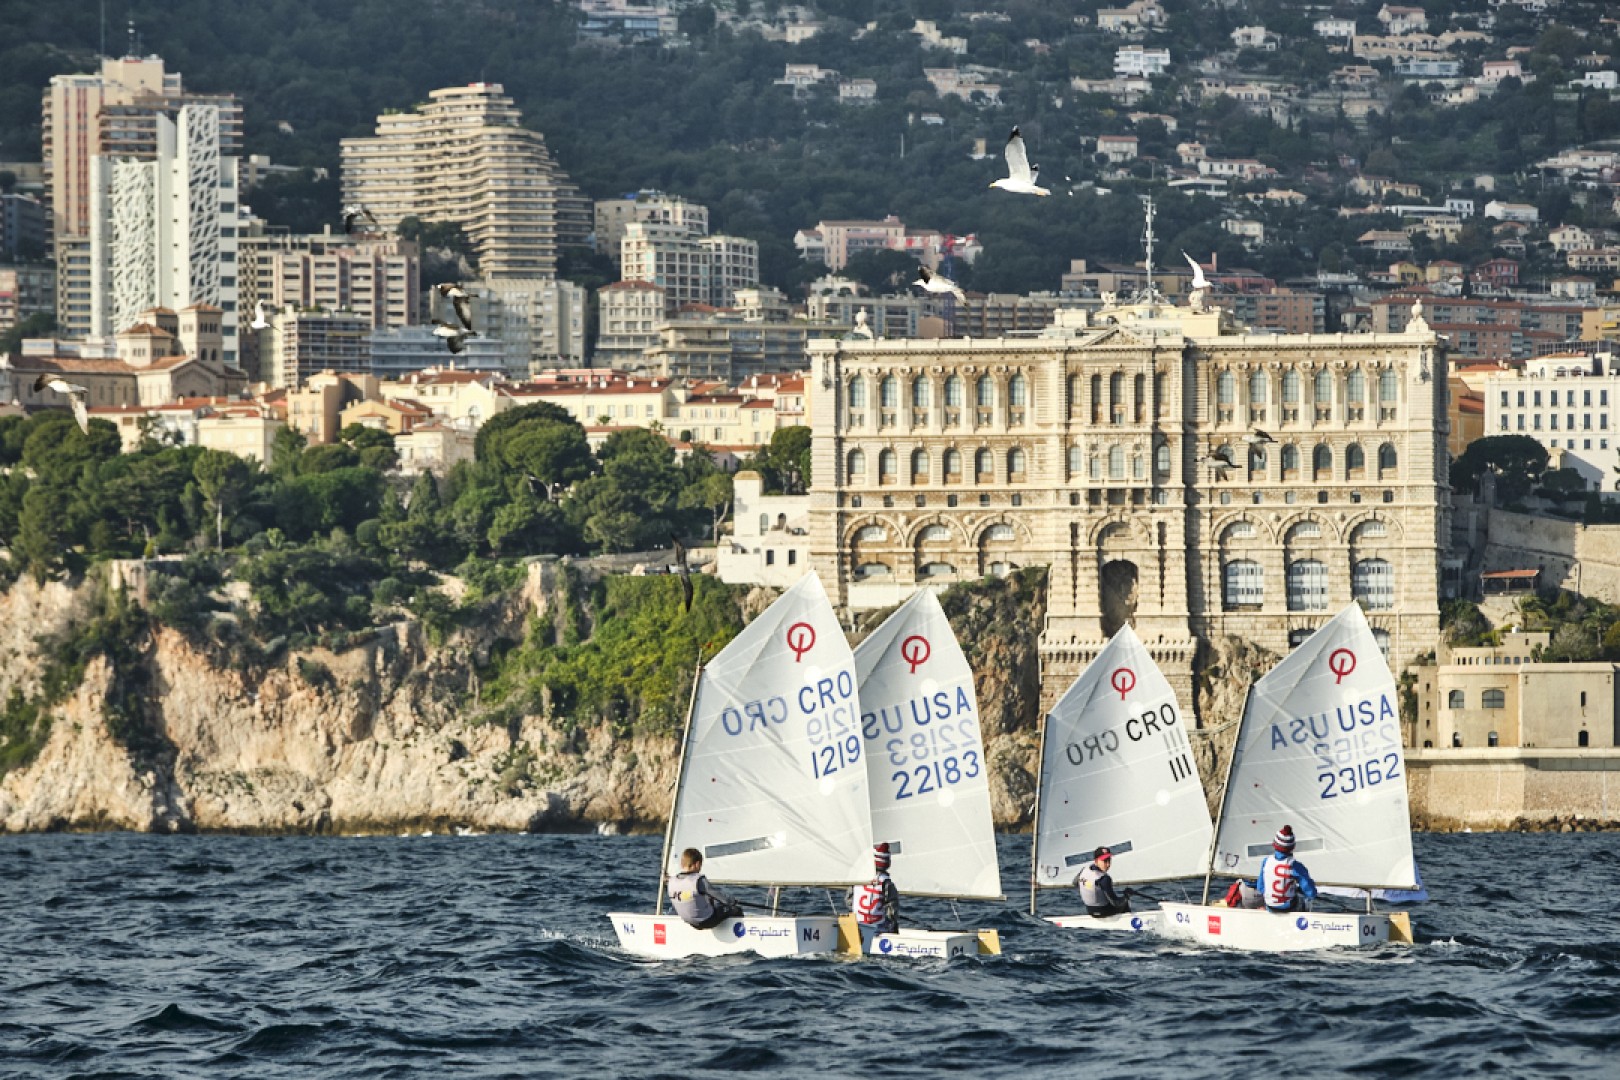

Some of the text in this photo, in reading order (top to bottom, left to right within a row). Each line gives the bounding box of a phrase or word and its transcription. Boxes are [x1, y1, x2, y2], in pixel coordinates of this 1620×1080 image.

[798, 670, 852, 714] CRO
[910, 686, 971, 725] USA
[1126, 703, 1176, 741] CRO
[1336, 694, 1394, 732] USA
[811, 735, 860, 779] 1219
[891, 750, 979, 800] 22183
[1318, 753, 1400, 799] 23162
[1271, 864, 1292, 904] USA
[623, 922, 635, 935] N4
[803, 927, 820, 942] N4
